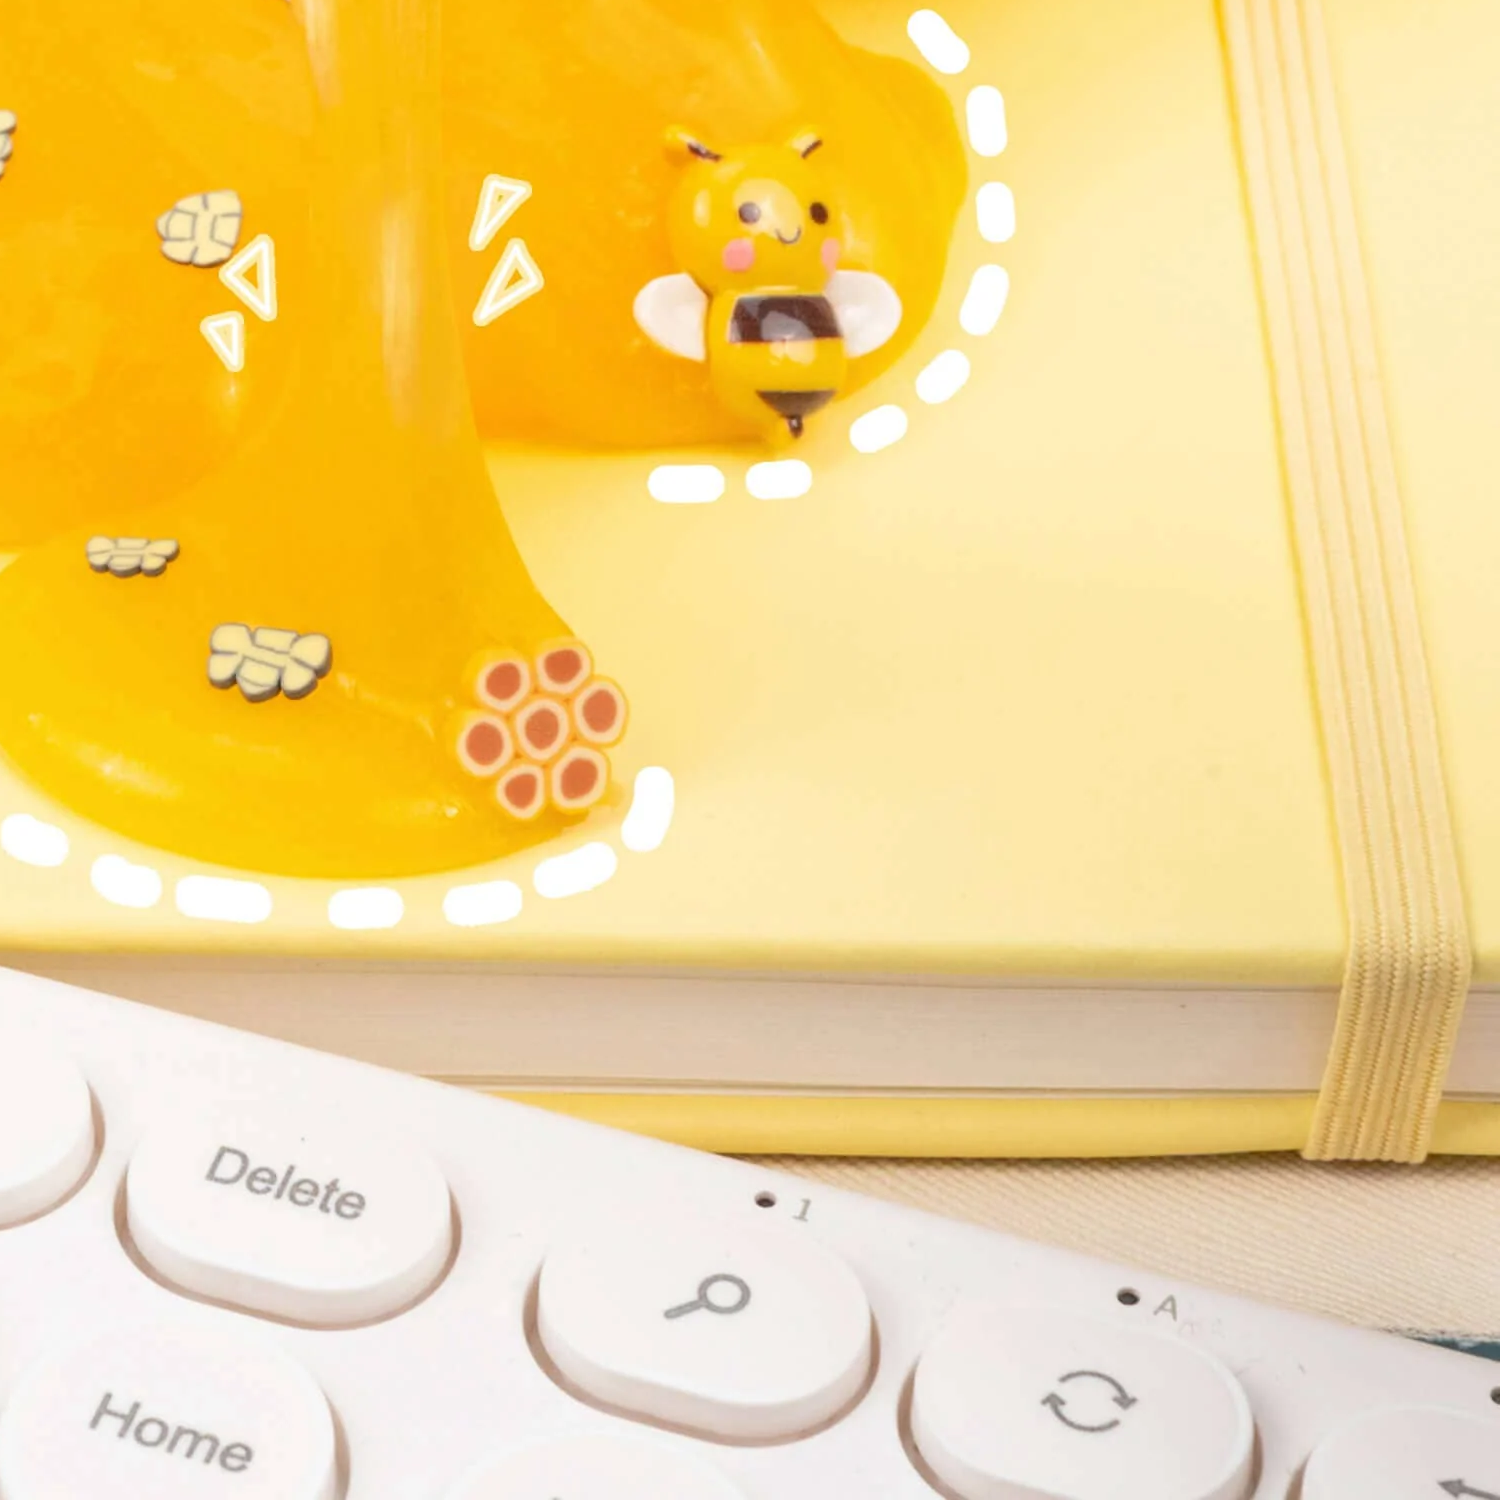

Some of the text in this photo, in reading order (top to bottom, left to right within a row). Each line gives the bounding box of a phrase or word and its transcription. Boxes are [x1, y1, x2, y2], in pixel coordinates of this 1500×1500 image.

[205, 1145, 367, 1220] Delete
[1153, 1294, 1178, 1322] A
[89, 1392, 254, 1473] Home
